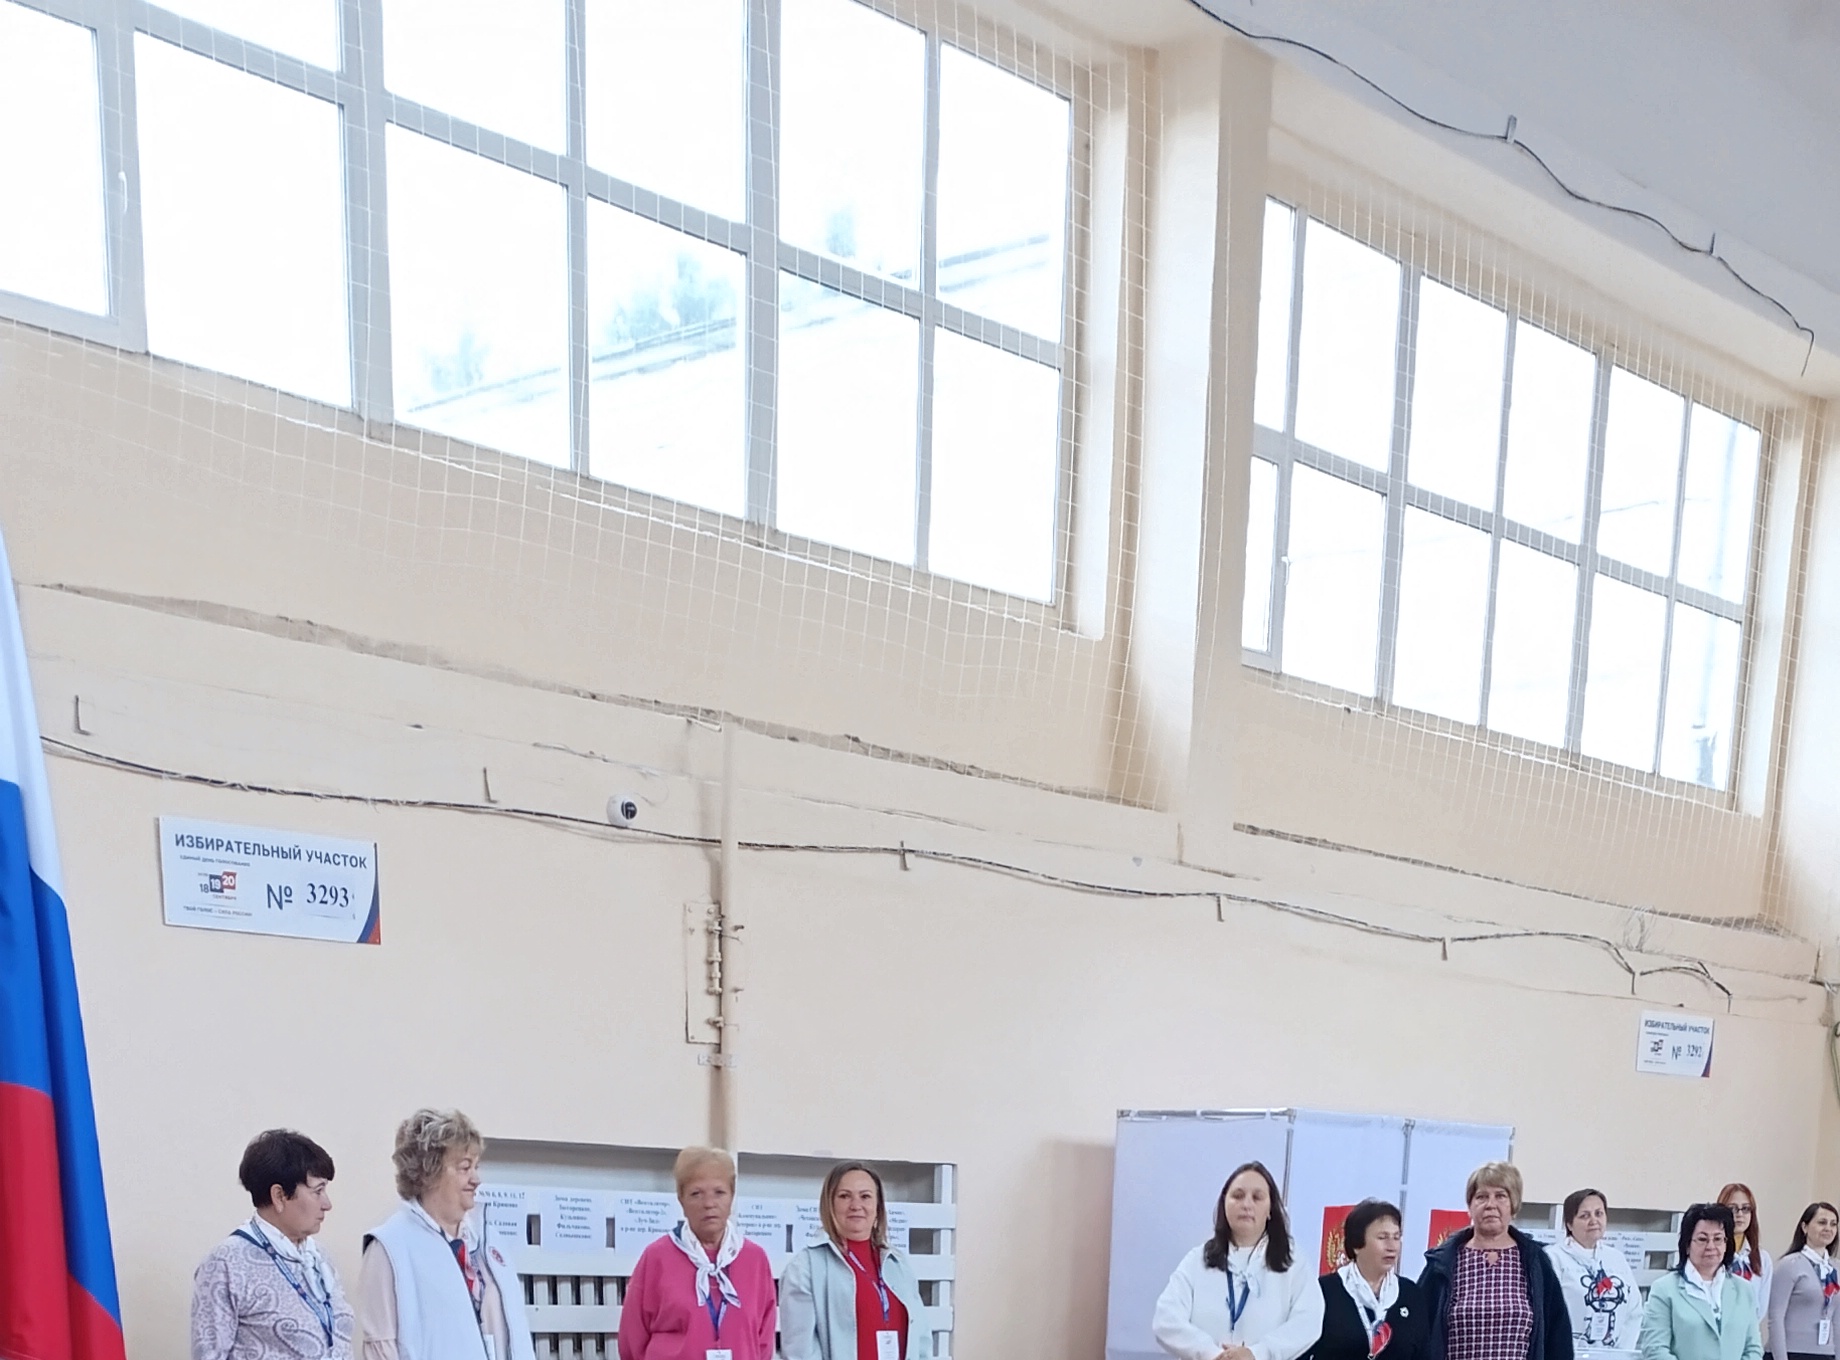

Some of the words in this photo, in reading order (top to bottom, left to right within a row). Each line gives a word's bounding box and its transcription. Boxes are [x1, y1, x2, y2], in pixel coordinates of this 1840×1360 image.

[175, 833, 302, 861] ИЗБИРАТЕЛЬНЫЙ
[306, 849, 367, 869] УЧАСТОК
[199, 883, 209, 893] 18
[210, 878, 221, 890] 19
[222, 874, 235, 886] 20
[266, 883, 293, 911] №
[306, 882, 350, 908] 3293
